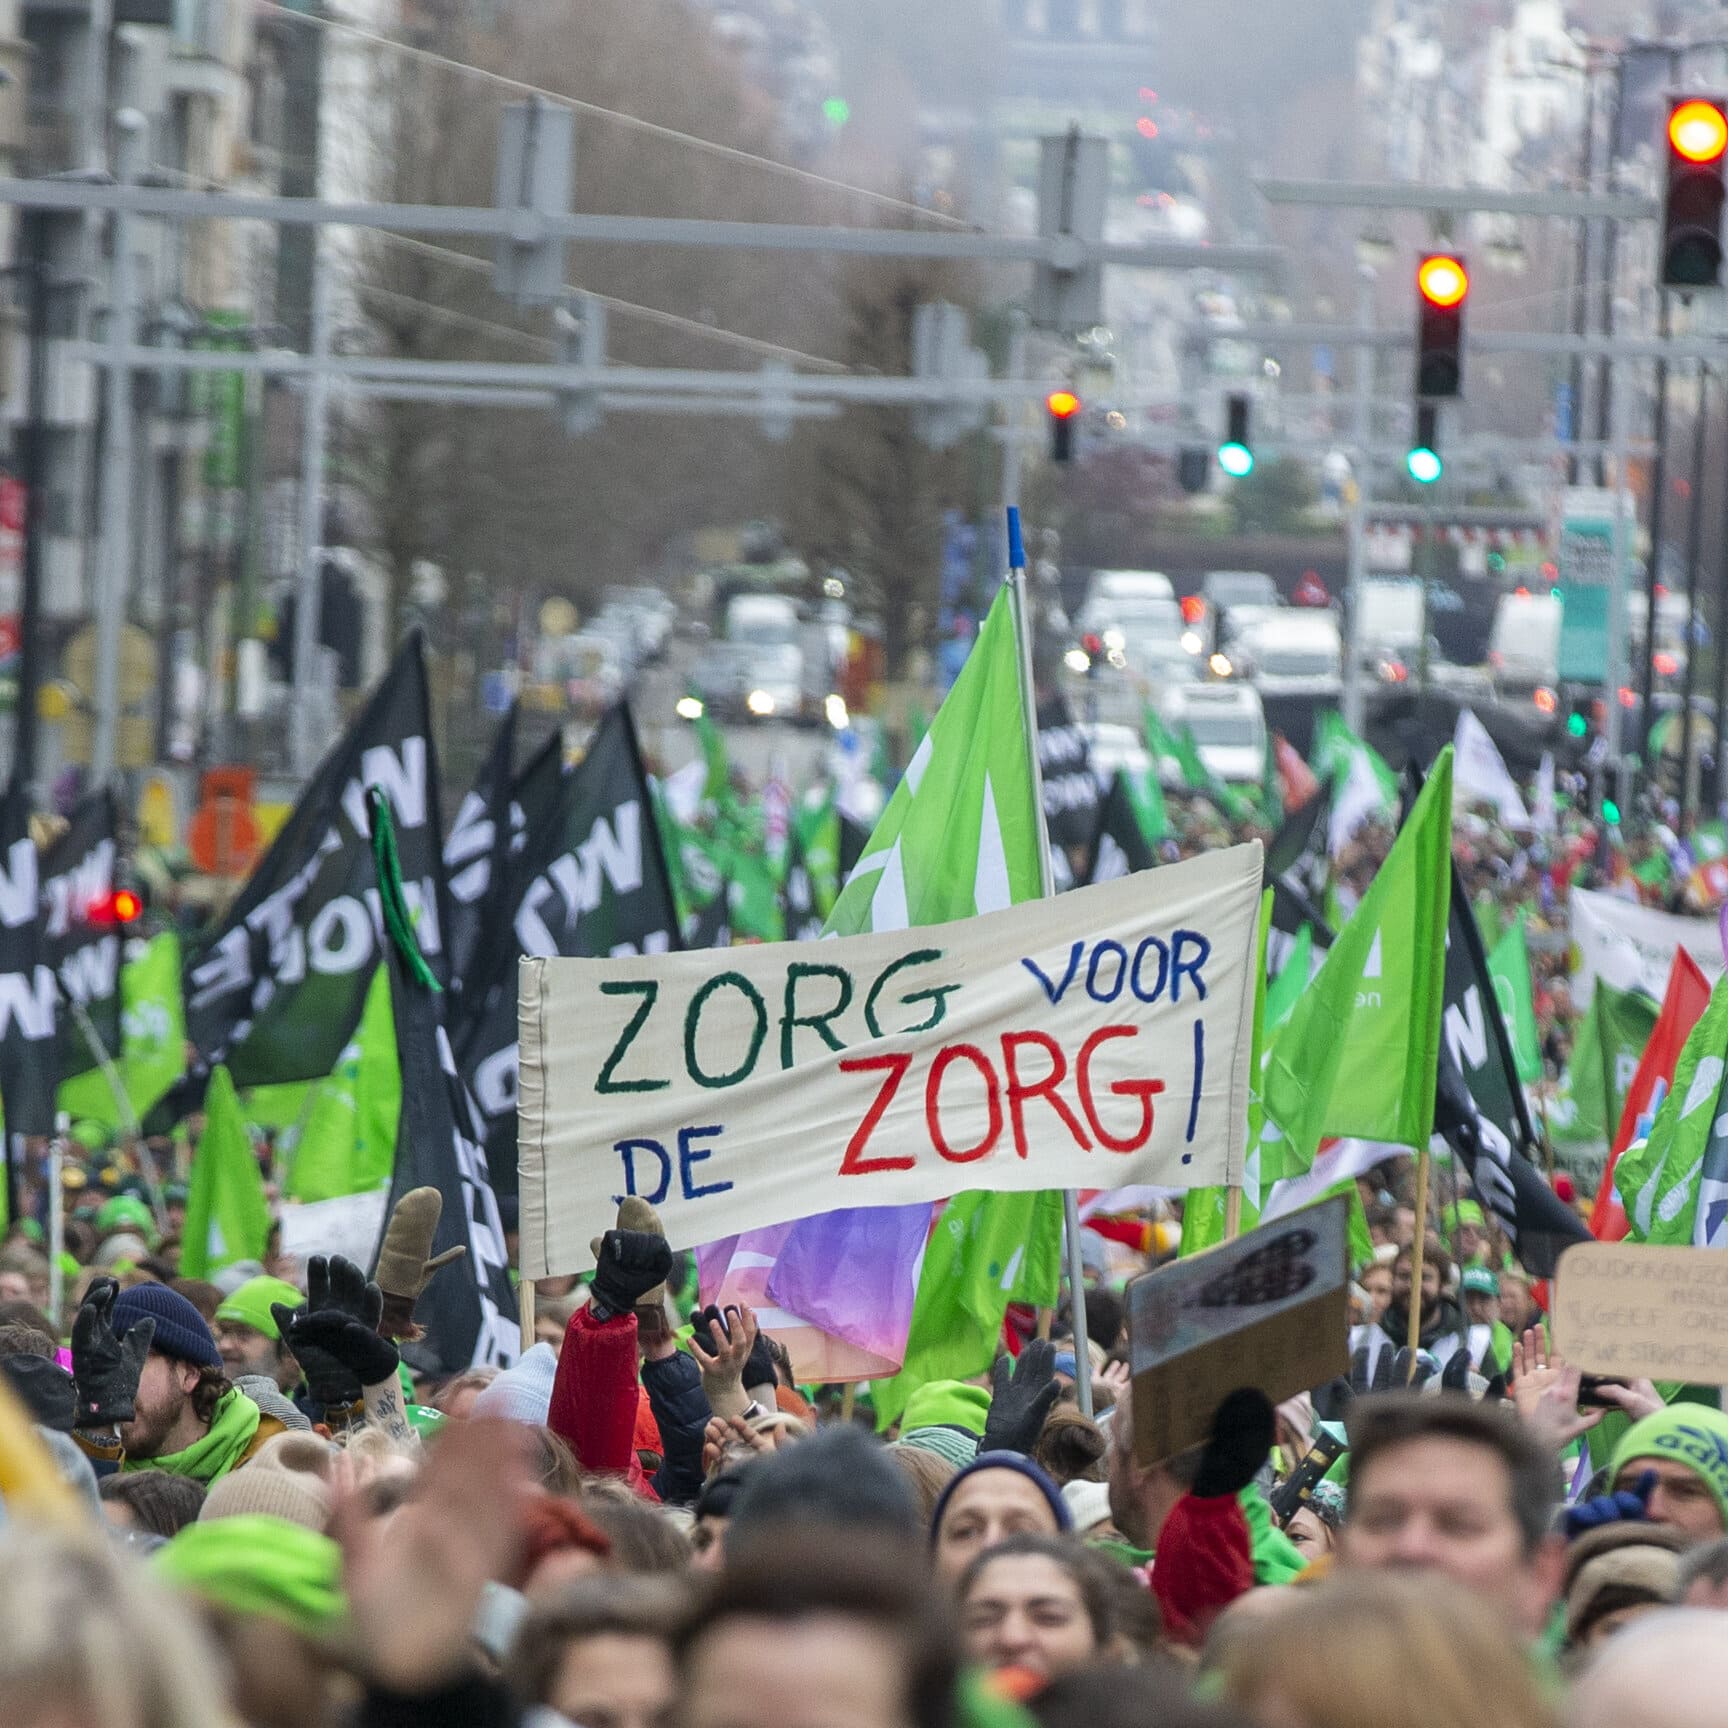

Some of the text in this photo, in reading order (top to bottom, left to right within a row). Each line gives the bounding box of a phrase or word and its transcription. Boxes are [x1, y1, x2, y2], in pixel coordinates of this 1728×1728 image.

[593, 929, 1211, 1095] ZORG VOOR
[612, 1124, 735, 1205] DE
